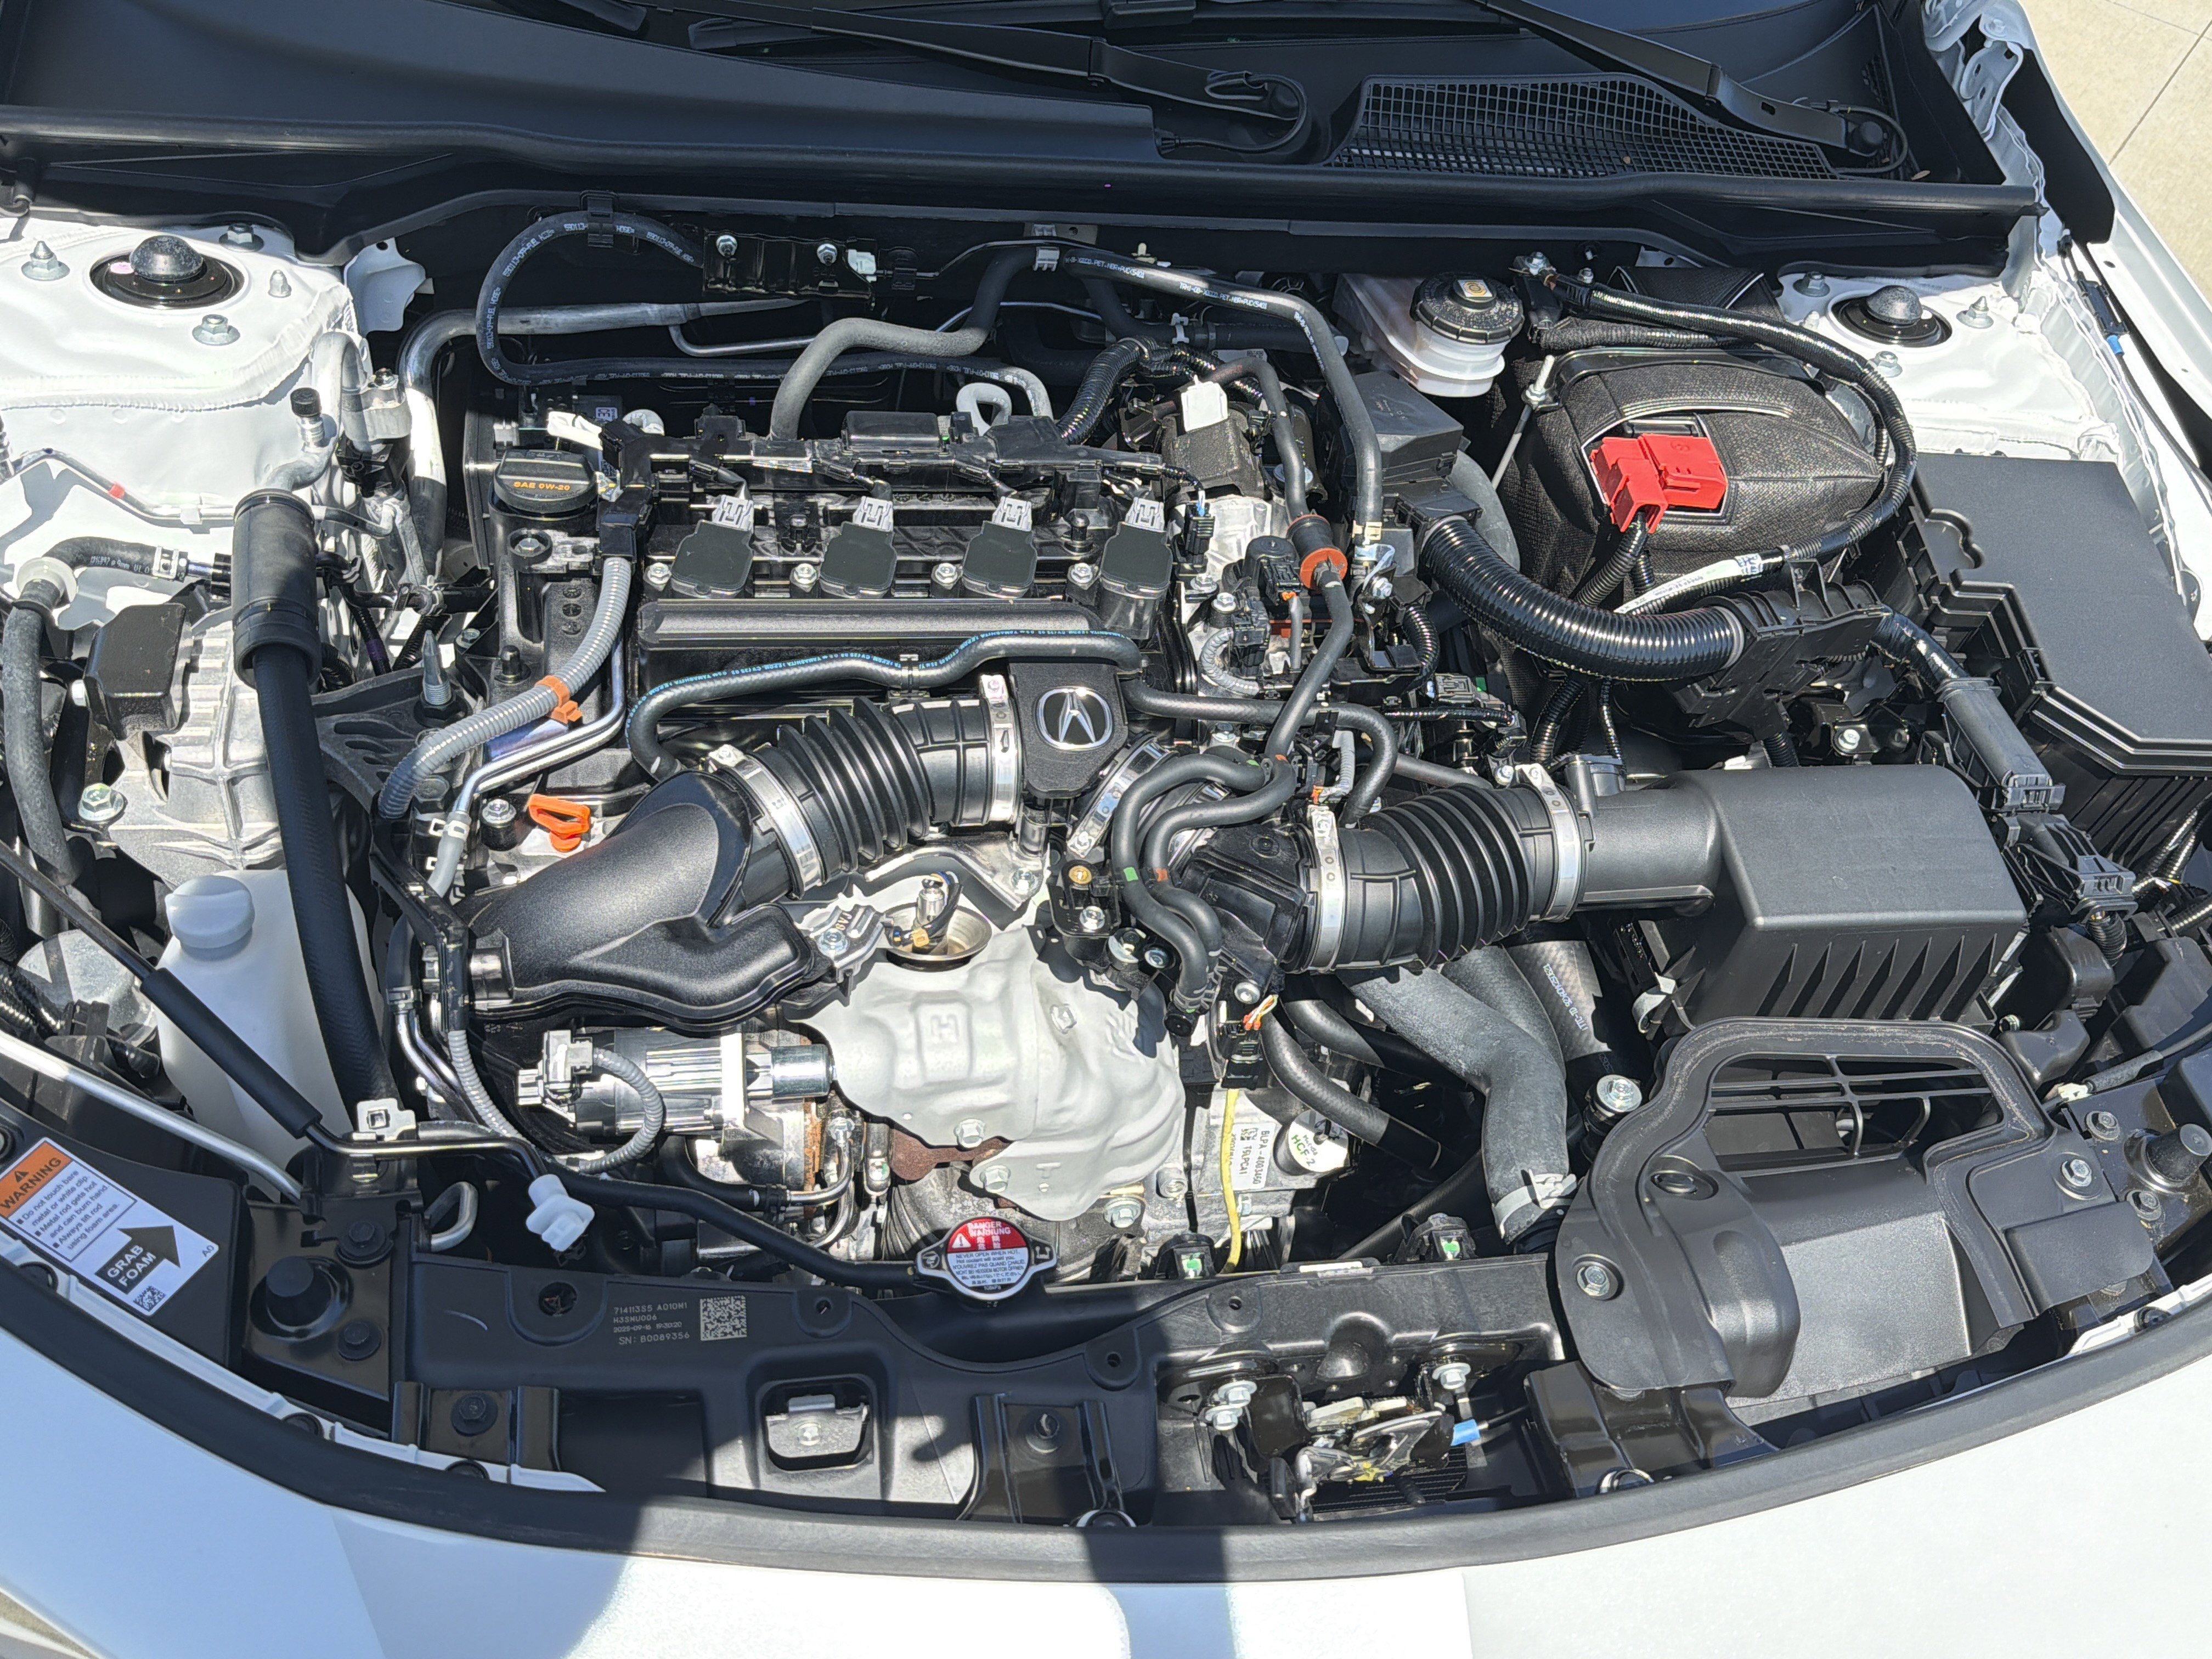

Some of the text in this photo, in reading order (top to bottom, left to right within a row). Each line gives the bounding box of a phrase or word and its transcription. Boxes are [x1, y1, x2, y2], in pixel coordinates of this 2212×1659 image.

[538, 483, 570, 491] 0W-20
[1, 1158, 61, 1210] WARNING
[22, 1170, 78, 1221] Do not touch bare
[32, 1209, 50, 1226] metal
[58, 1186, 76, 1202] white
[40, 1181, 97, 1231] Metal rod gets hot
[50, 1184, 109, 1237] and can burn hand.
[58, 1203, 102, 1244] Always lift rod
[67, 1202, 119, 1250] using foam area.
[967, 1221, 1002, 1231] DANGER
[107, 1245, 143, 1278] GRAB
[119, 1252, 156, 1287] FOAM
[619, 1336, 636, 1345] SN:
